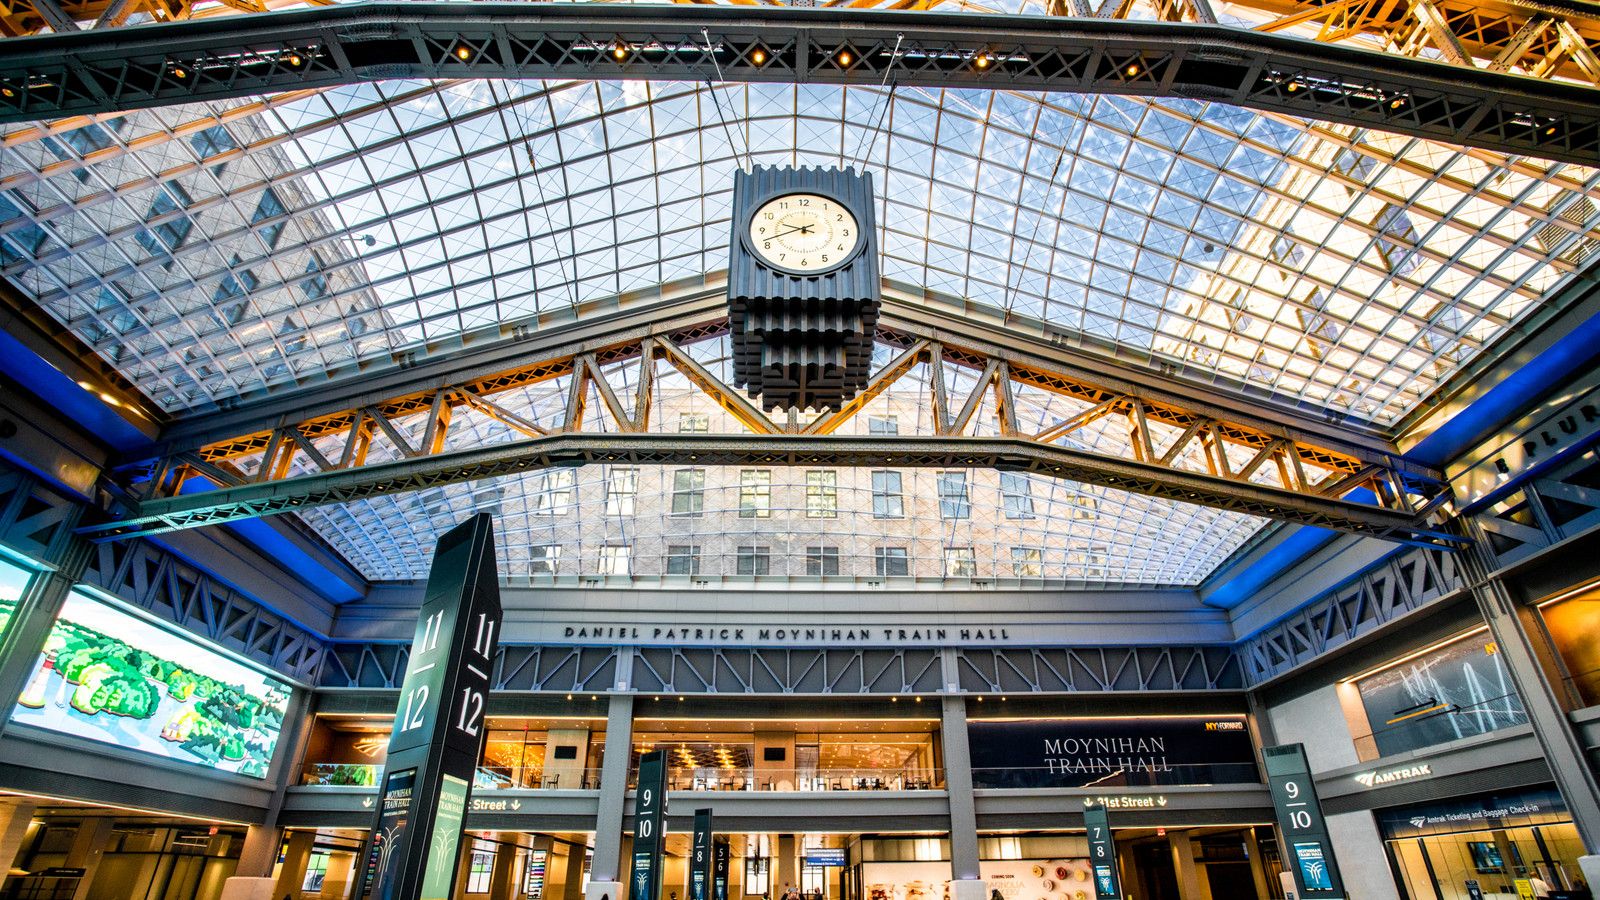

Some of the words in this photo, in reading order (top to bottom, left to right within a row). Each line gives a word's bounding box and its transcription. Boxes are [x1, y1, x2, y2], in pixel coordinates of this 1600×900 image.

[799, 199, 809, 207] 12
[764, 212, 774, 220] 10
[843, 229, 849, 237] 3
[779, 253, 786, 261] 7
[419, 609, 444, 655] 11
[473, 613, 495, 660] 11
[564, 627, 639, 638] DANIEL
[653, 628, 744, 640] PATRICK
[759, 629, 870, 640] MOYNIHAN
[884, 629, 946, 640] TRAIN
[960, 629, 1009, 640] HALL
[401, 685, 430, 733] 12
[456, 687, 483, 737] 12
[1044, 737, 1165, 755] MOYNIHAN
[1044, 757, 1112, 774] TRAIN
[1118, 756, 1173, 773] HALL
[1375, 765, 1431, 784] AMTRAK
[1285, 781, 1299, 799] 9
[643, 789, 652, 807] 9
[1121, 796, 1154, 807] Street
[473, 799, 506, 811] Street
[1289, 810, 1312, 829] 10
[1427, 815, 1446, 824] Amtrak
[1446, 812, 1472, 821] Ticketing
[1483, 808, 1509, 818] Baggage
[1509, 804, 1539, 814] Check-in
[638, 820, 652, 838] 10
[1093, 827, 1101, 839] 7
[698, 832, 704, 843] 7
[696, 851, 703, 862] 8
[718, 848, 724, 857] 5
[1096, 845, 1105, 857] 8
[717, 862, 723, 871] 6
